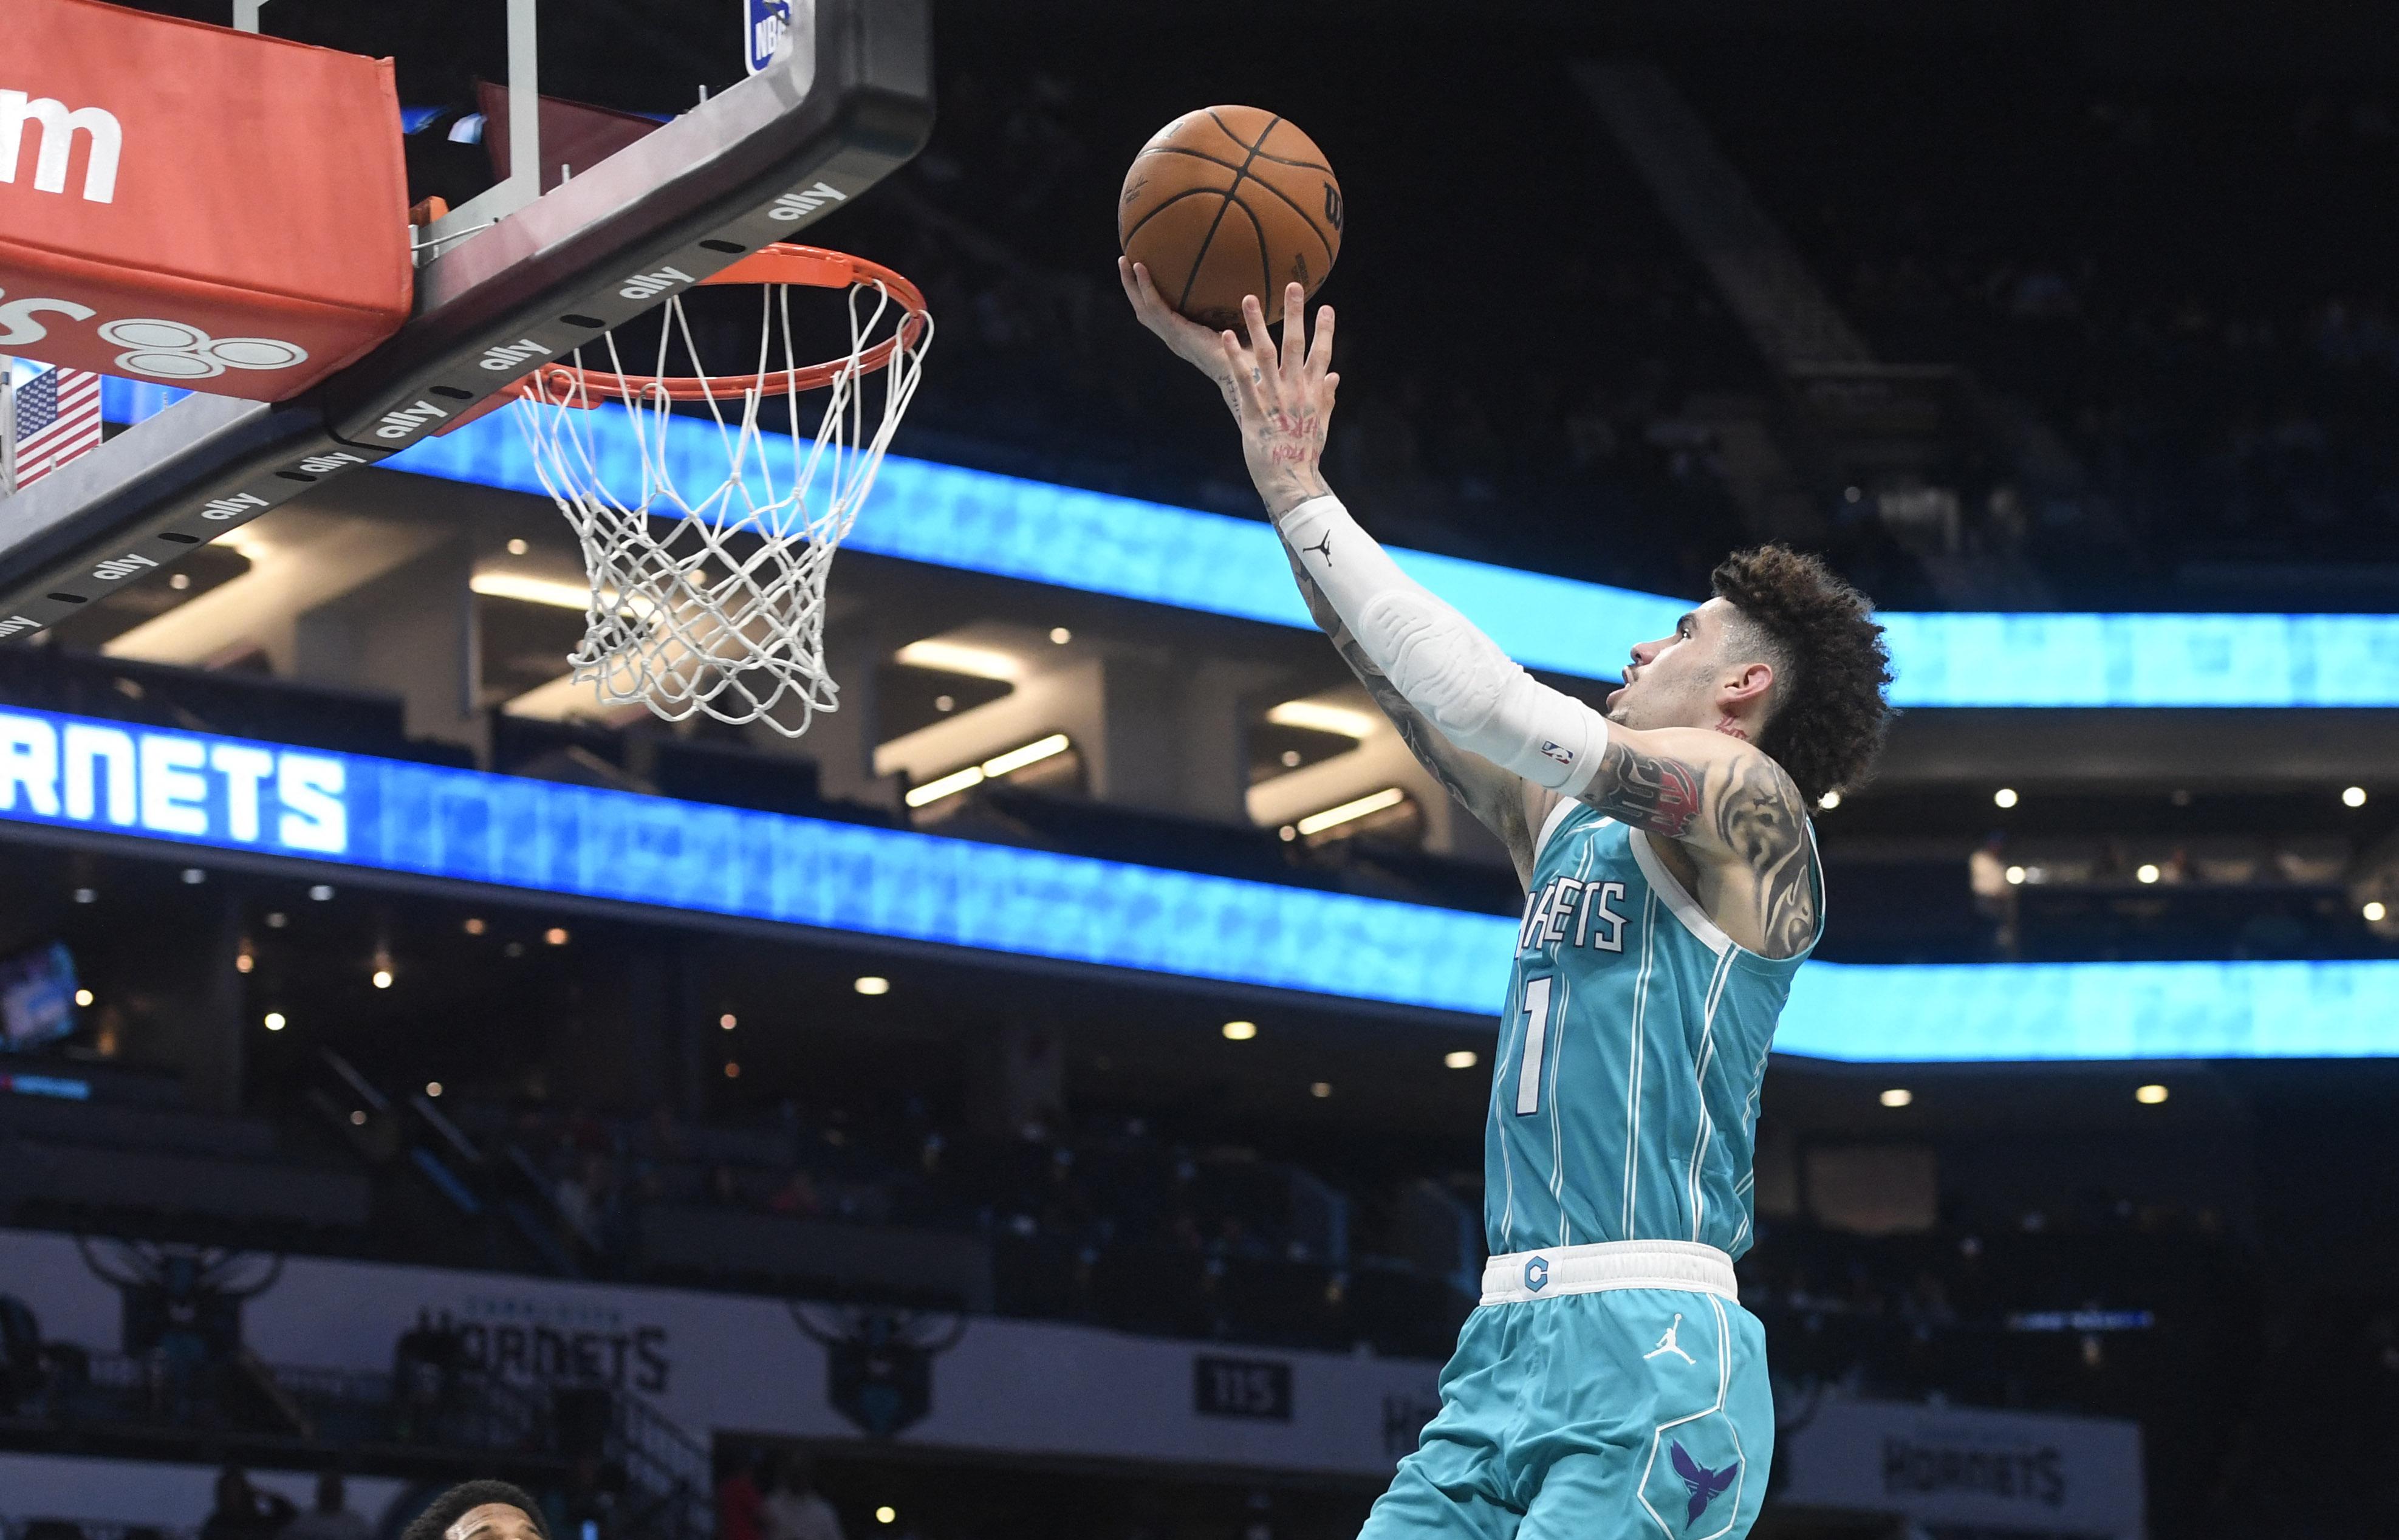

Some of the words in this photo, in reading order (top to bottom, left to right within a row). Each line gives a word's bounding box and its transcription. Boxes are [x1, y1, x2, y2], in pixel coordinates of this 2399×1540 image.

[768, 182, 847, 221] ally
[619, 266, 696, 300] ally
[479, 338, 552, 371] ally
[375, 400, 449, 439] ally
[299, 451, 368, 473] ally
[201, 492, 270, 521] ally
[92, 553, 159, 580] ally
[1516, 975, 1553, 1117] 1
